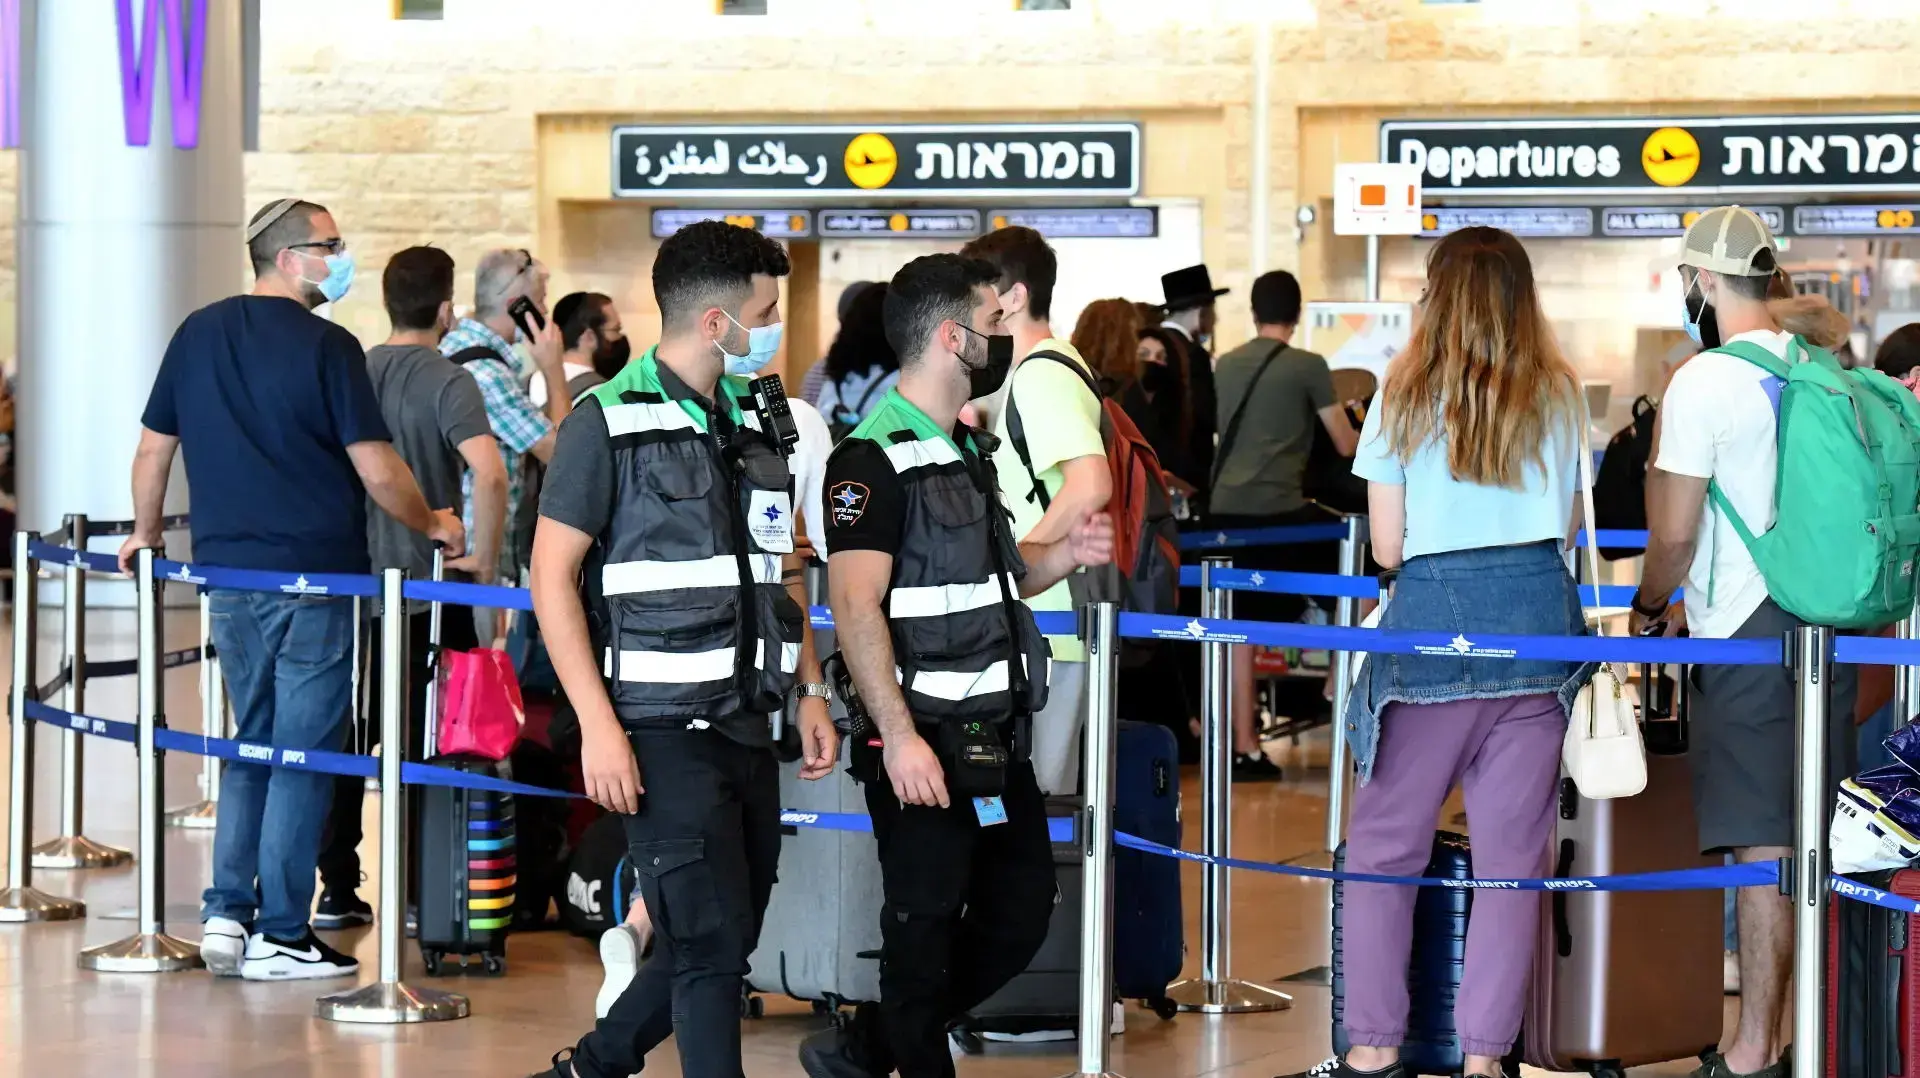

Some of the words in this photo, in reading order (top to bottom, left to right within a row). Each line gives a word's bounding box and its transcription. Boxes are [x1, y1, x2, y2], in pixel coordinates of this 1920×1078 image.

[635, 138, 730, 186] المغادرة
[738, 140, 827, 186] رحلات
[914, 141, 1115, 180] המראות
[1400, 139, 1621, 187] Departures
[1722, 133, 1920, 176] מראות
[1441, 879, 1520, 889] SECURITY
[1543, 879, 1598, 890] ביטחון
[1831, 878, 1887, 901] URITY
